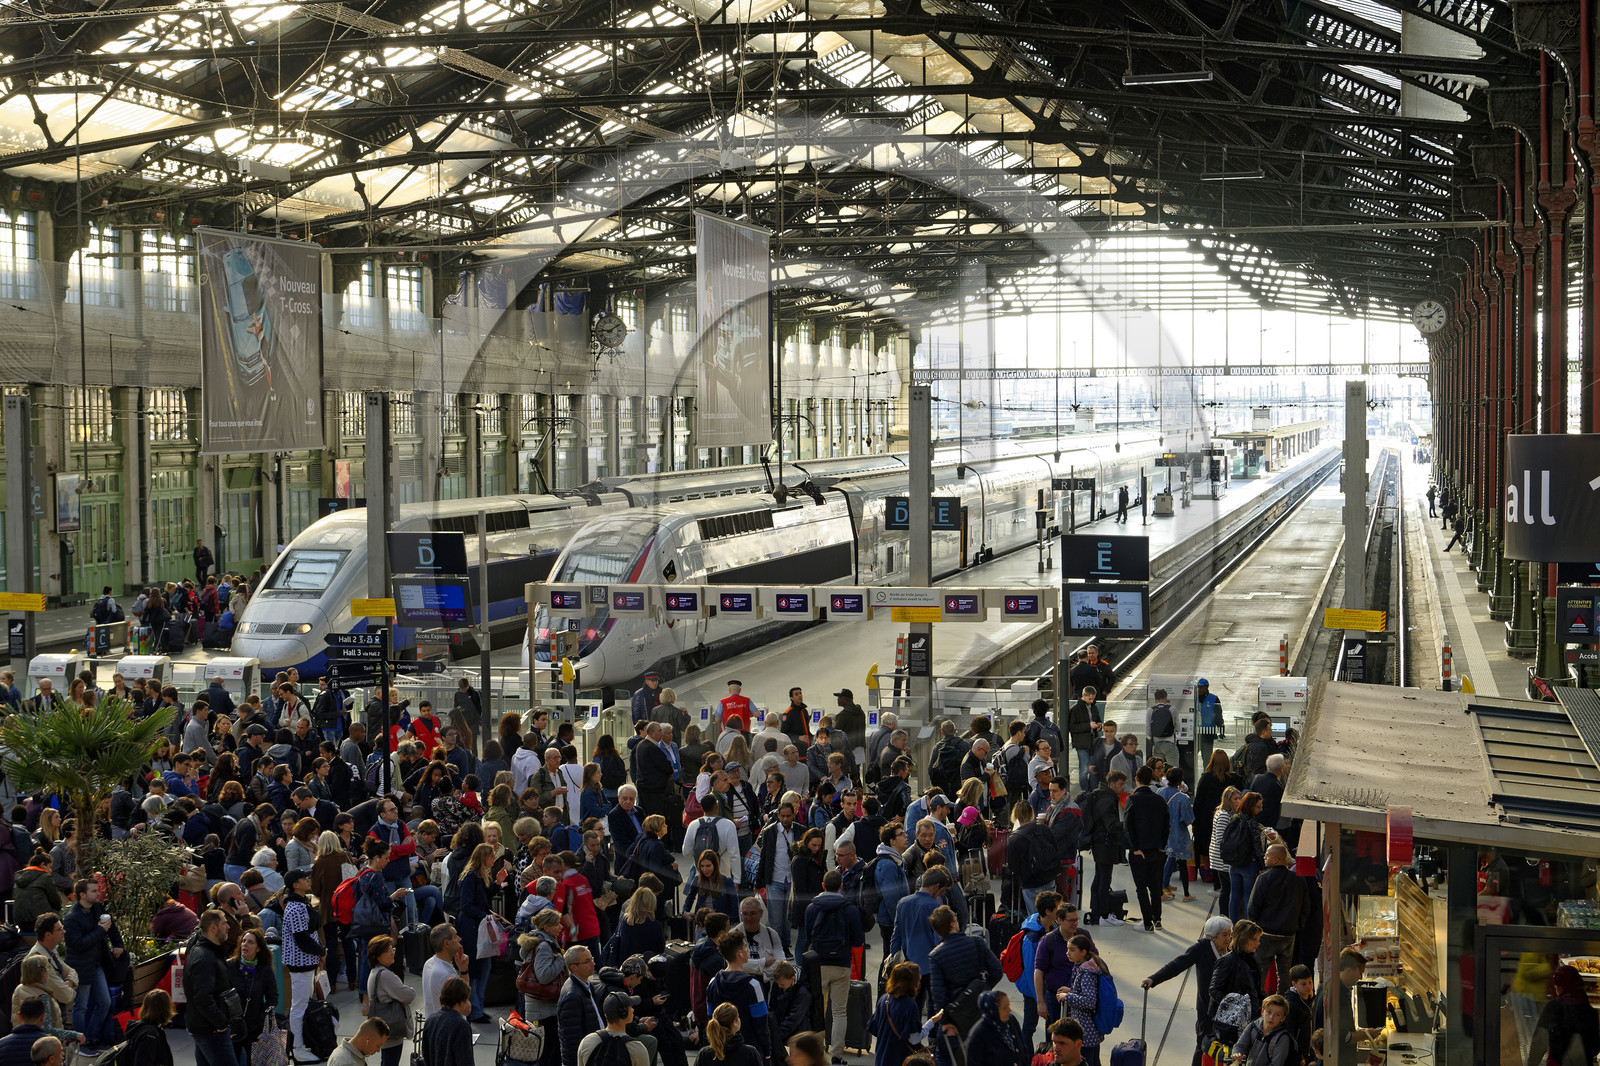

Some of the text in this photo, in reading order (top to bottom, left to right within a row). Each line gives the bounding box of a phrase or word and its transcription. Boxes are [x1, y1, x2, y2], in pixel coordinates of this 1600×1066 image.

[722, 258, 746, 279] Nouveau
[280, 276, 316, 294] Nouveau
[280, 296, 313, 314] T-Cross.
[1505, 470, 1556, 526] all
[895, 507, 908, 522] D
[939, 508, 949, 523] E
[418, 546, 436, 565] D
[1098, 550, 1112, 570] E
[100, 634, 106, 645] C
[560, 641, 564, 653] D
